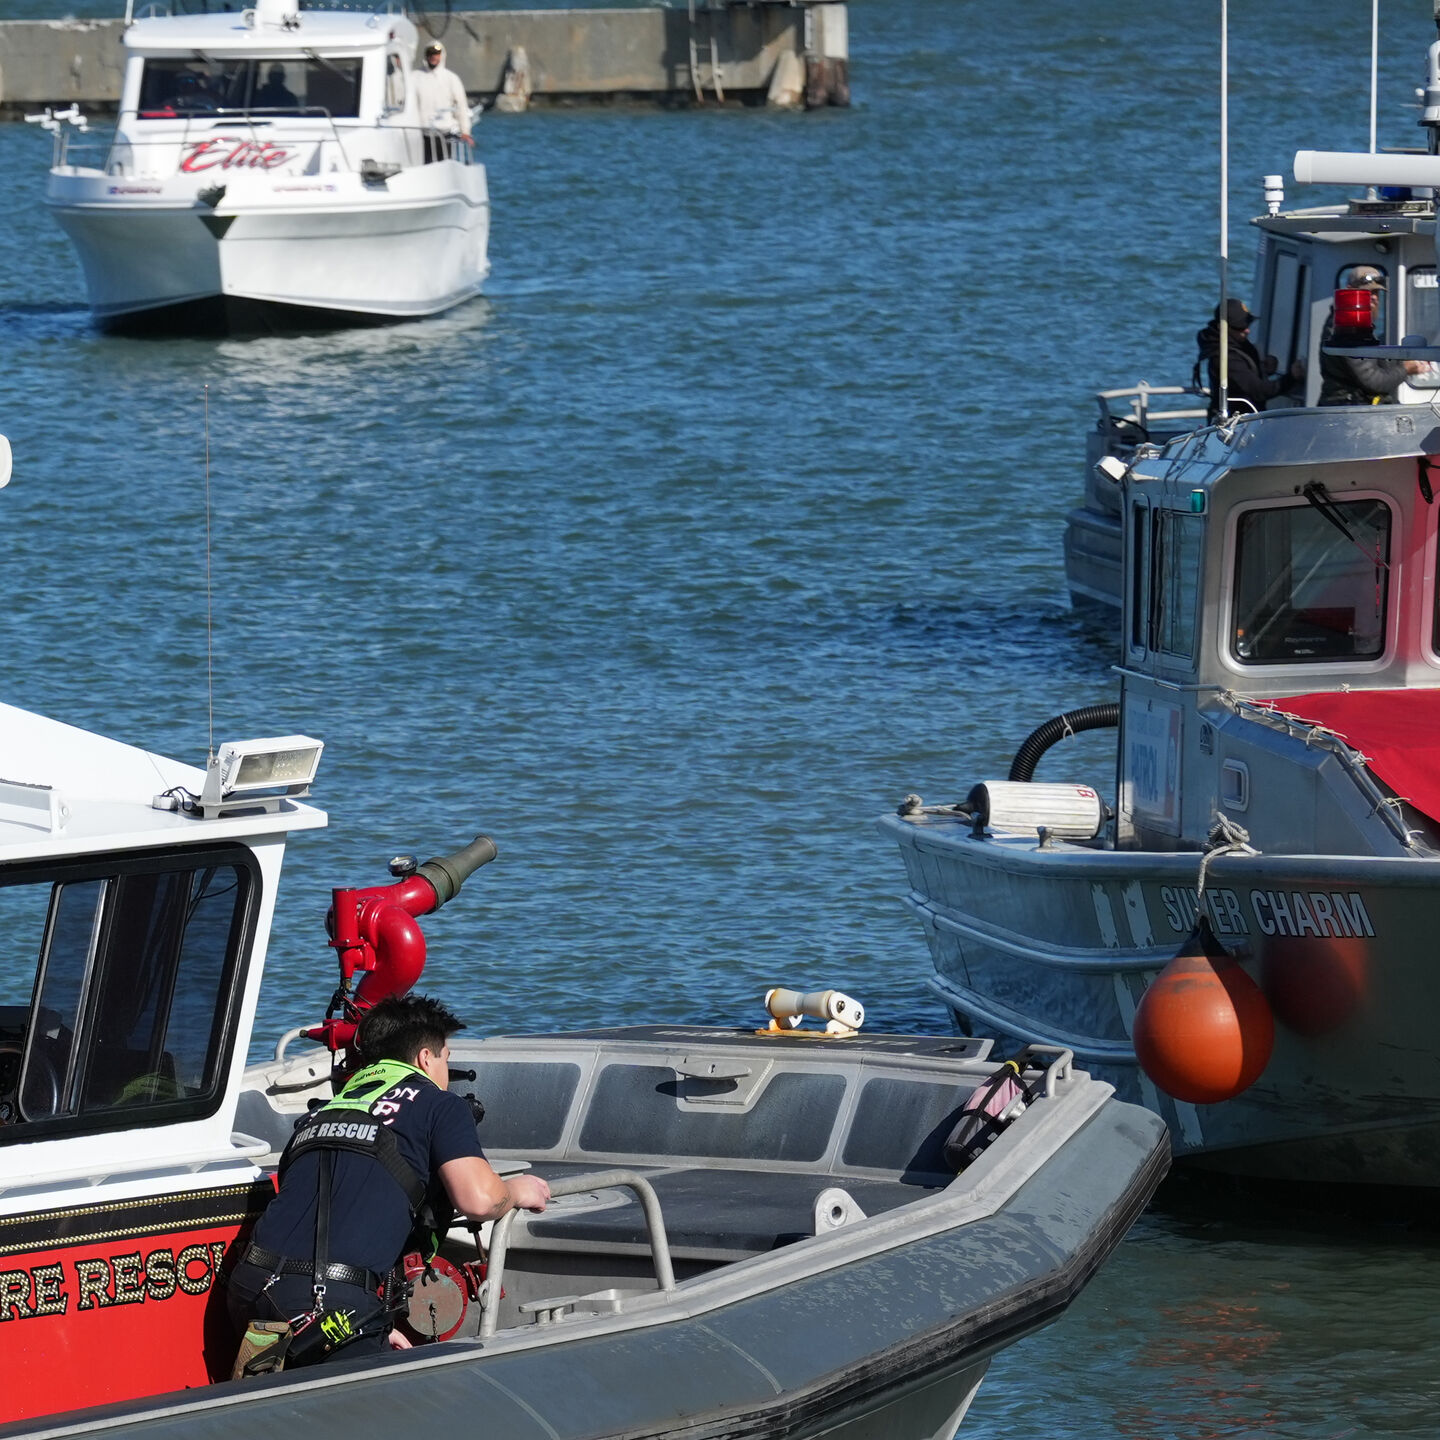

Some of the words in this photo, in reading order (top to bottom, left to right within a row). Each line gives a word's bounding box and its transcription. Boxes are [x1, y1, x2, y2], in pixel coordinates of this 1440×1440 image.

[180, 136, 298, 173] Elite
[1250, 888, 1377, 939] CHARM
[291, 1124, 319, 1149] FIRE
[317, 1122, 378, 1142] RESCUE
[75, 1241, 227, 1310] RESC
